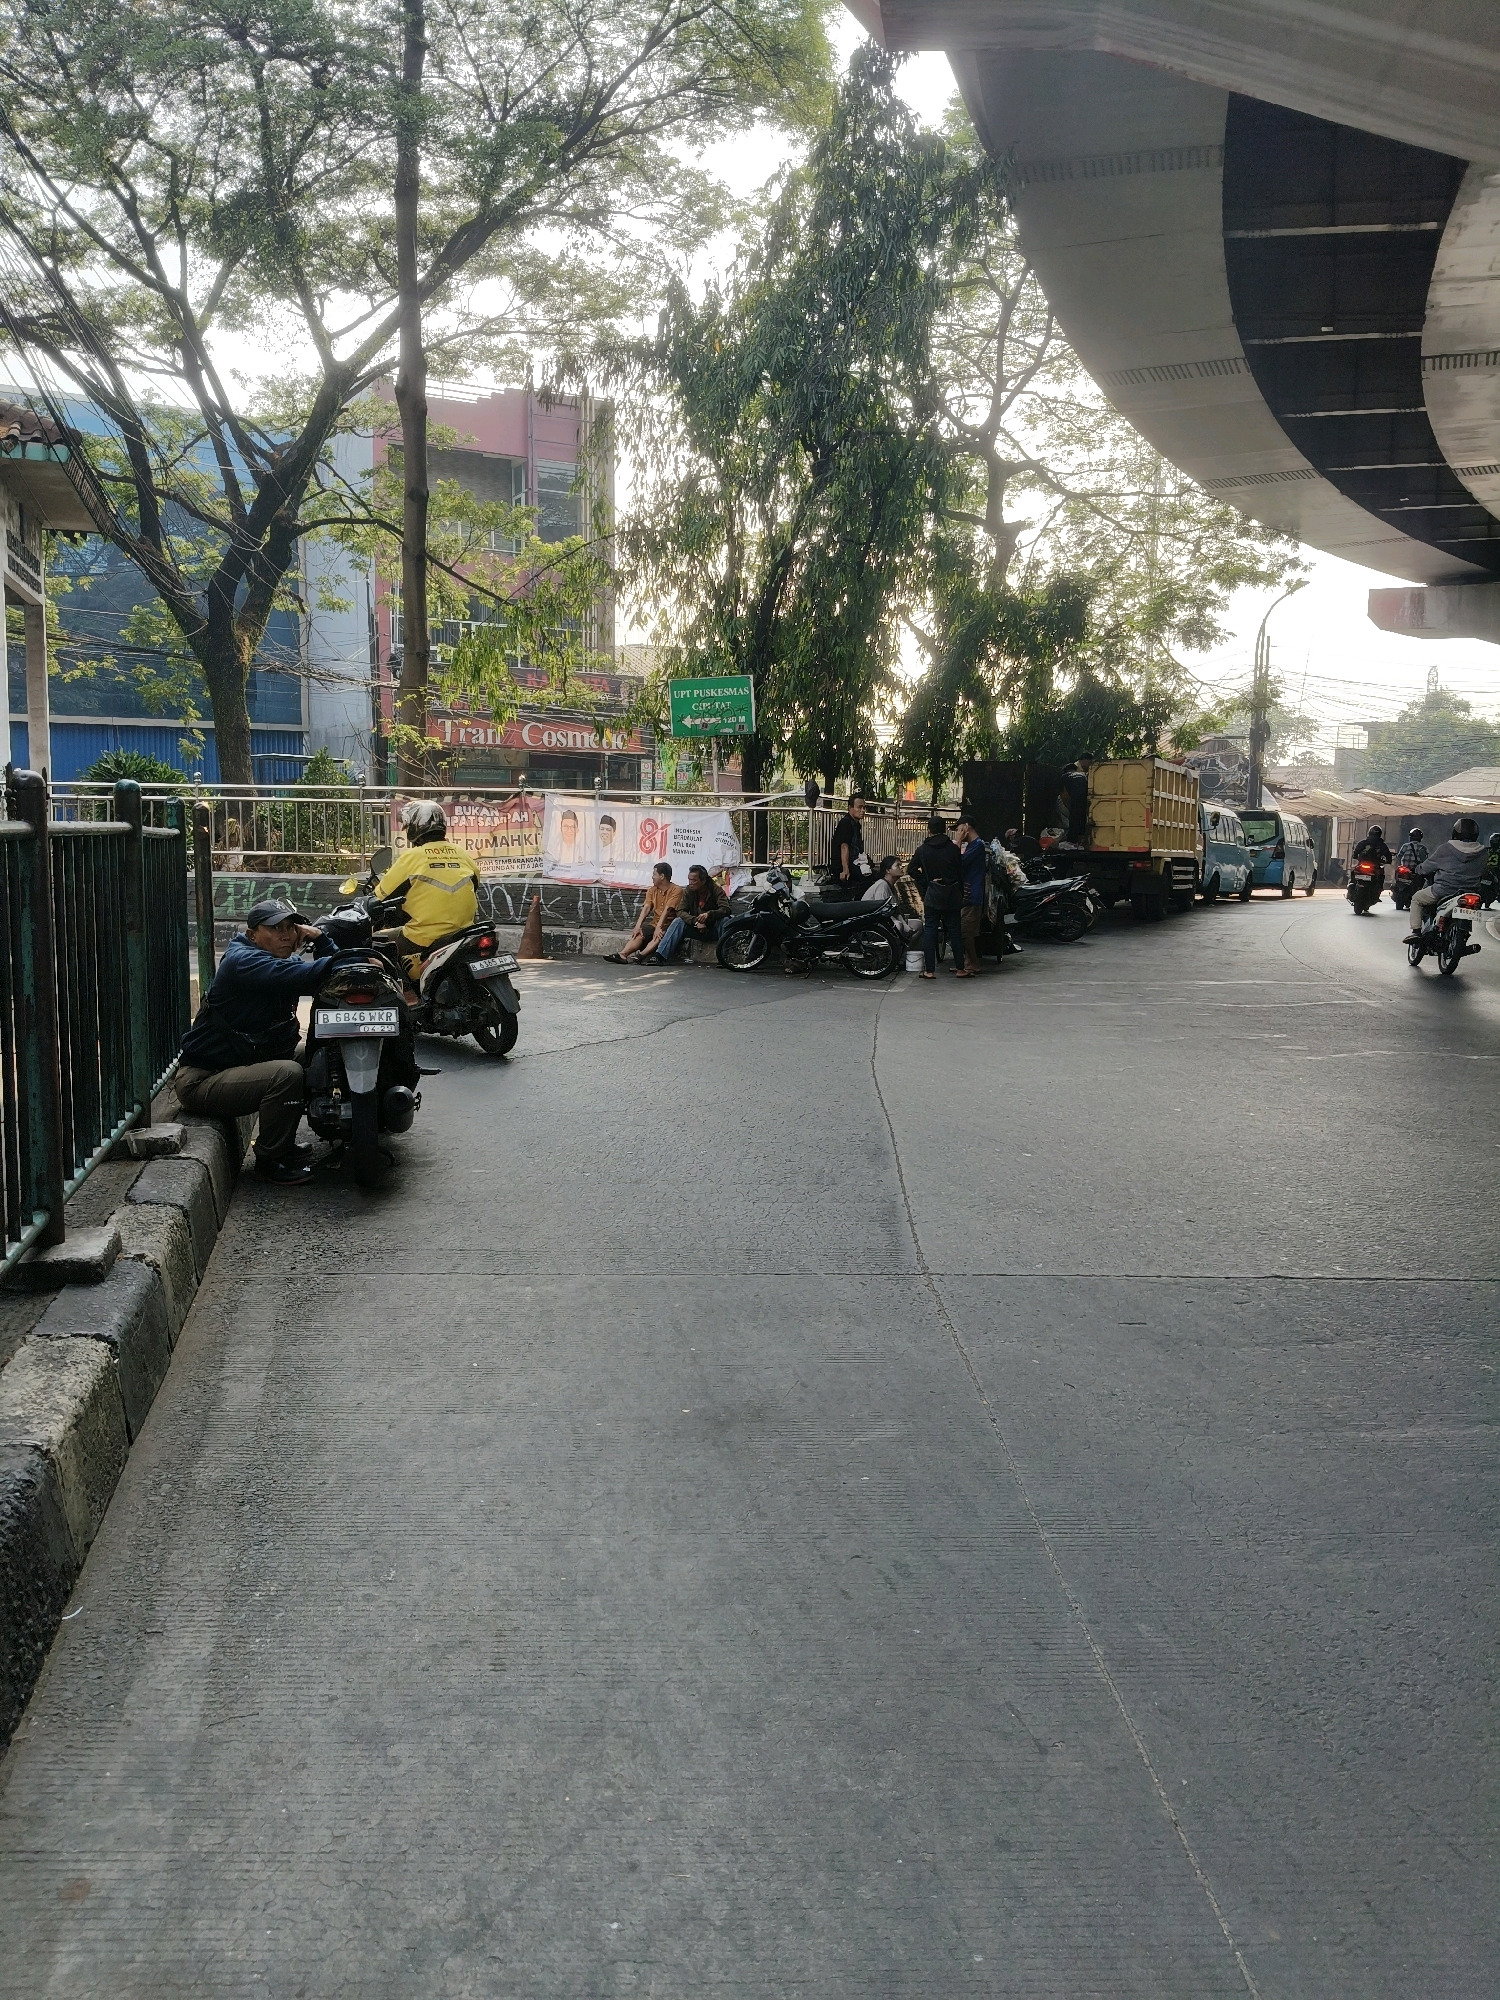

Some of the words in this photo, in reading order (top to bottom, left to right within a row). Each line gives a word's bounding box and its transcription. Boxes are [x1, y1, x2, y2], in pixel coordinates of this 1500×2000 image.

[673, 689, 691, 699] UPT
[693, 687, 749, 698] PUSKESMAS
[454, 805, 499, 817] BUKAN
[477, 811, 529, 827] SAMPAH
[465, 833, 520, 851] RUMAH
[639, 817, 672, 859] 81
[424, 846, 457, 855] maxim
[322, 1013, 330, 1024] B
[335, 1012, 366, 1023] 6846
[369, 1011, 393, 1022] WKR
